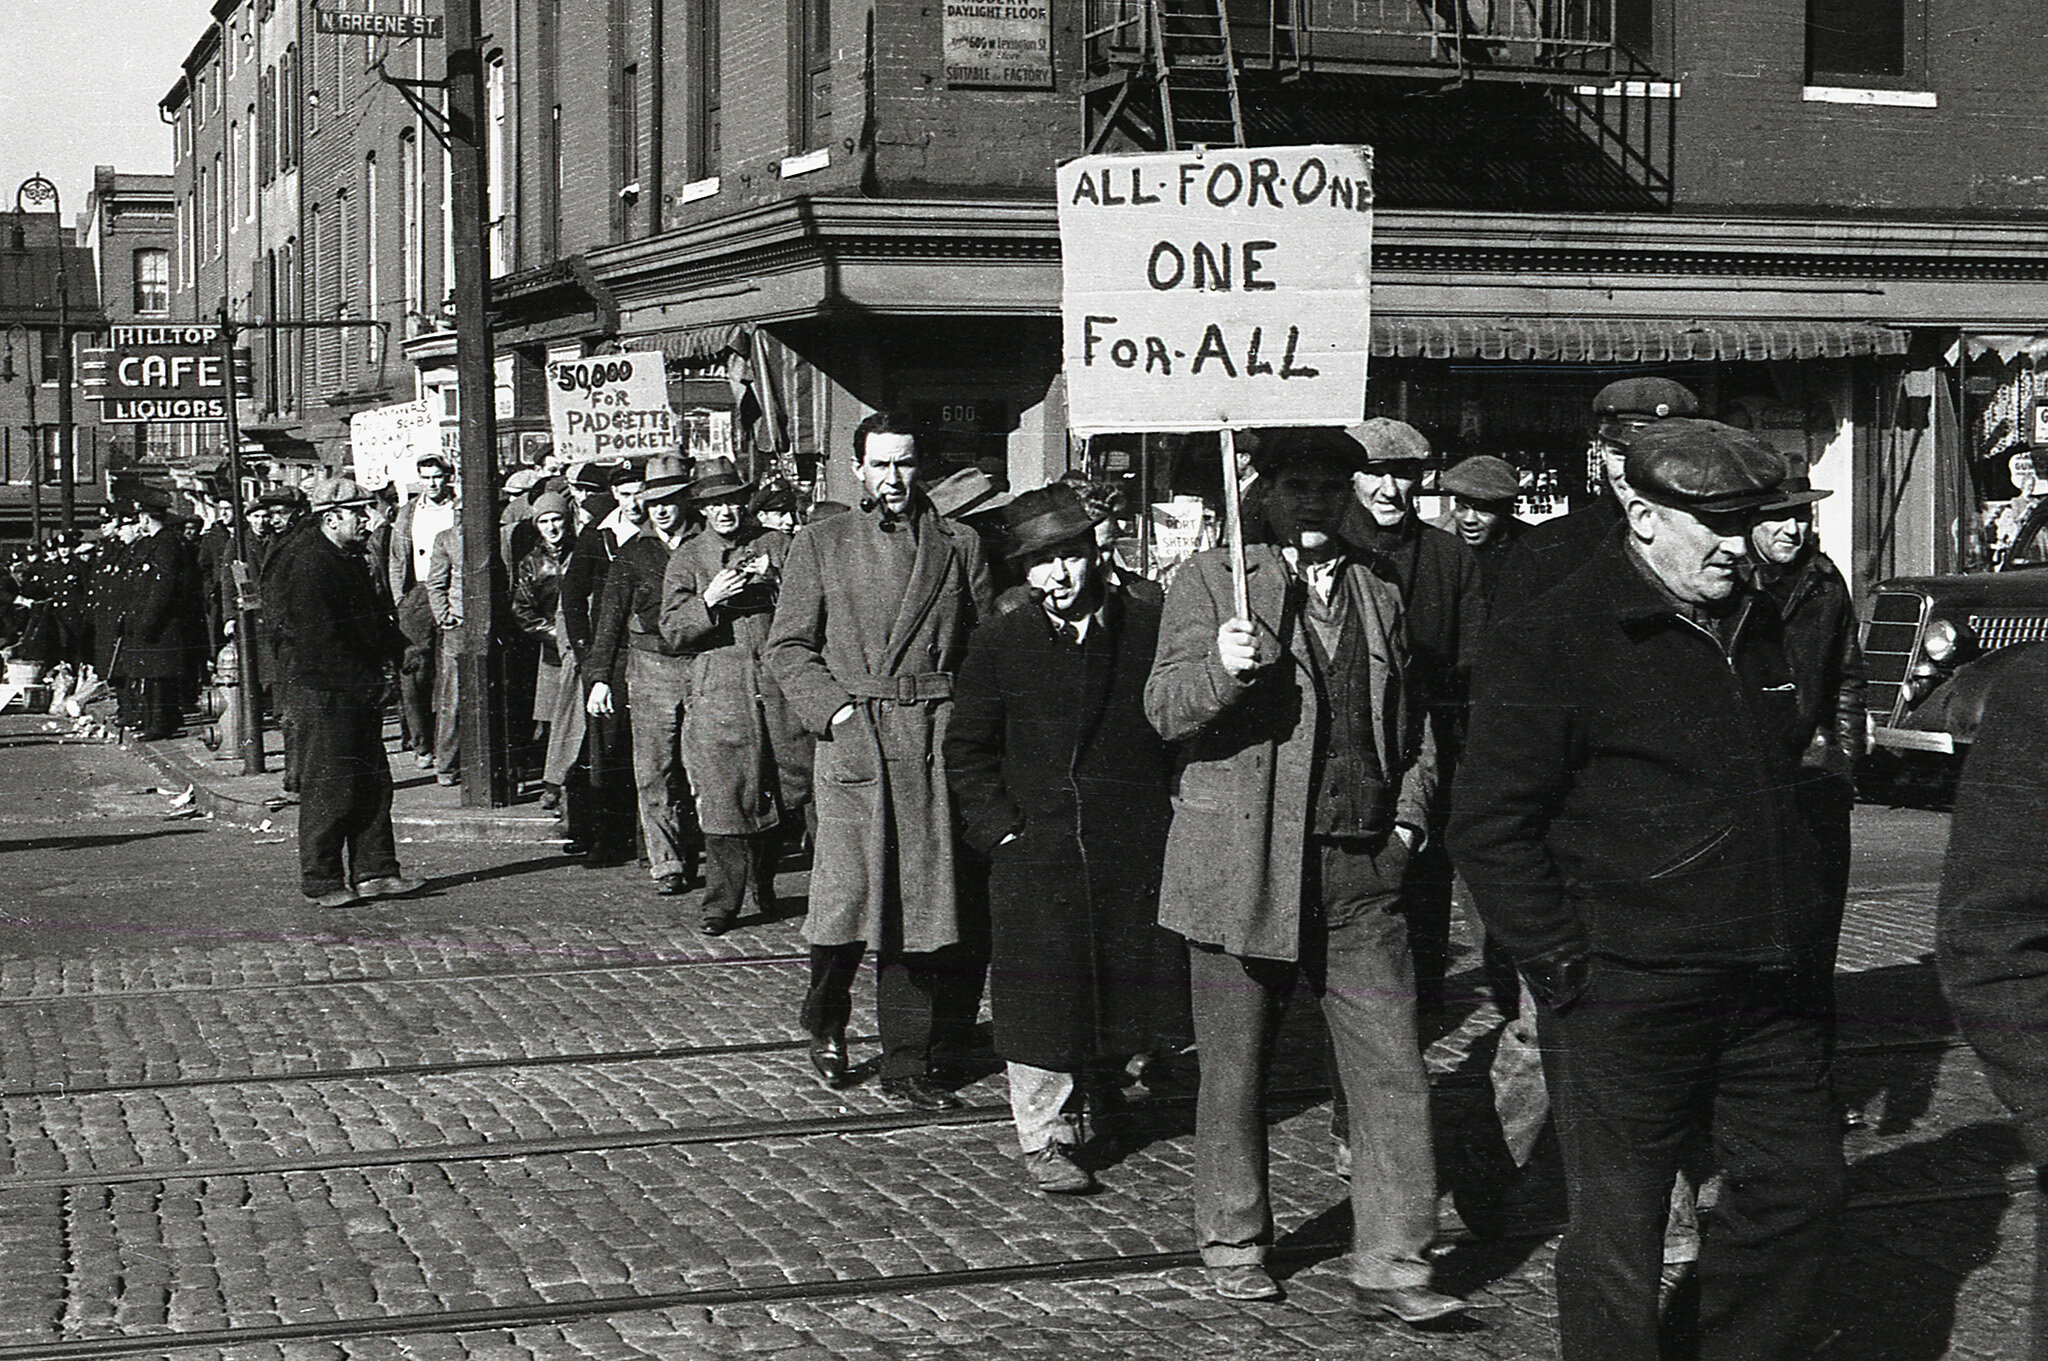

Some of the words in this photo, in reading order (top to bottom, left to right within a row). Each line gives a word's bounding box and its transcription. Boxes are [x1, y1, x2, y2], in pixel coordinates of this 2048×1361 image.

[948, 5, 1002, 18] DAYLIGHT
[1005, 7, 1046, 19] FLOOR
[322, 13, 334, 31] N
[339, 14, 408, 33] GREENE
[413, 17, 437, 35] ST.
[1004, 67, 1049, 82] FACTORY
[1148, 241, 1278, 291] ONE
[118, 328, 217, 345] HILLTOP
[118, 356, 222, 387] CAFE
[547, 360, 634, 400] $50,000
[116, 400, 224, 419] LIQUORS
[942, 405, 975, 421] 600
